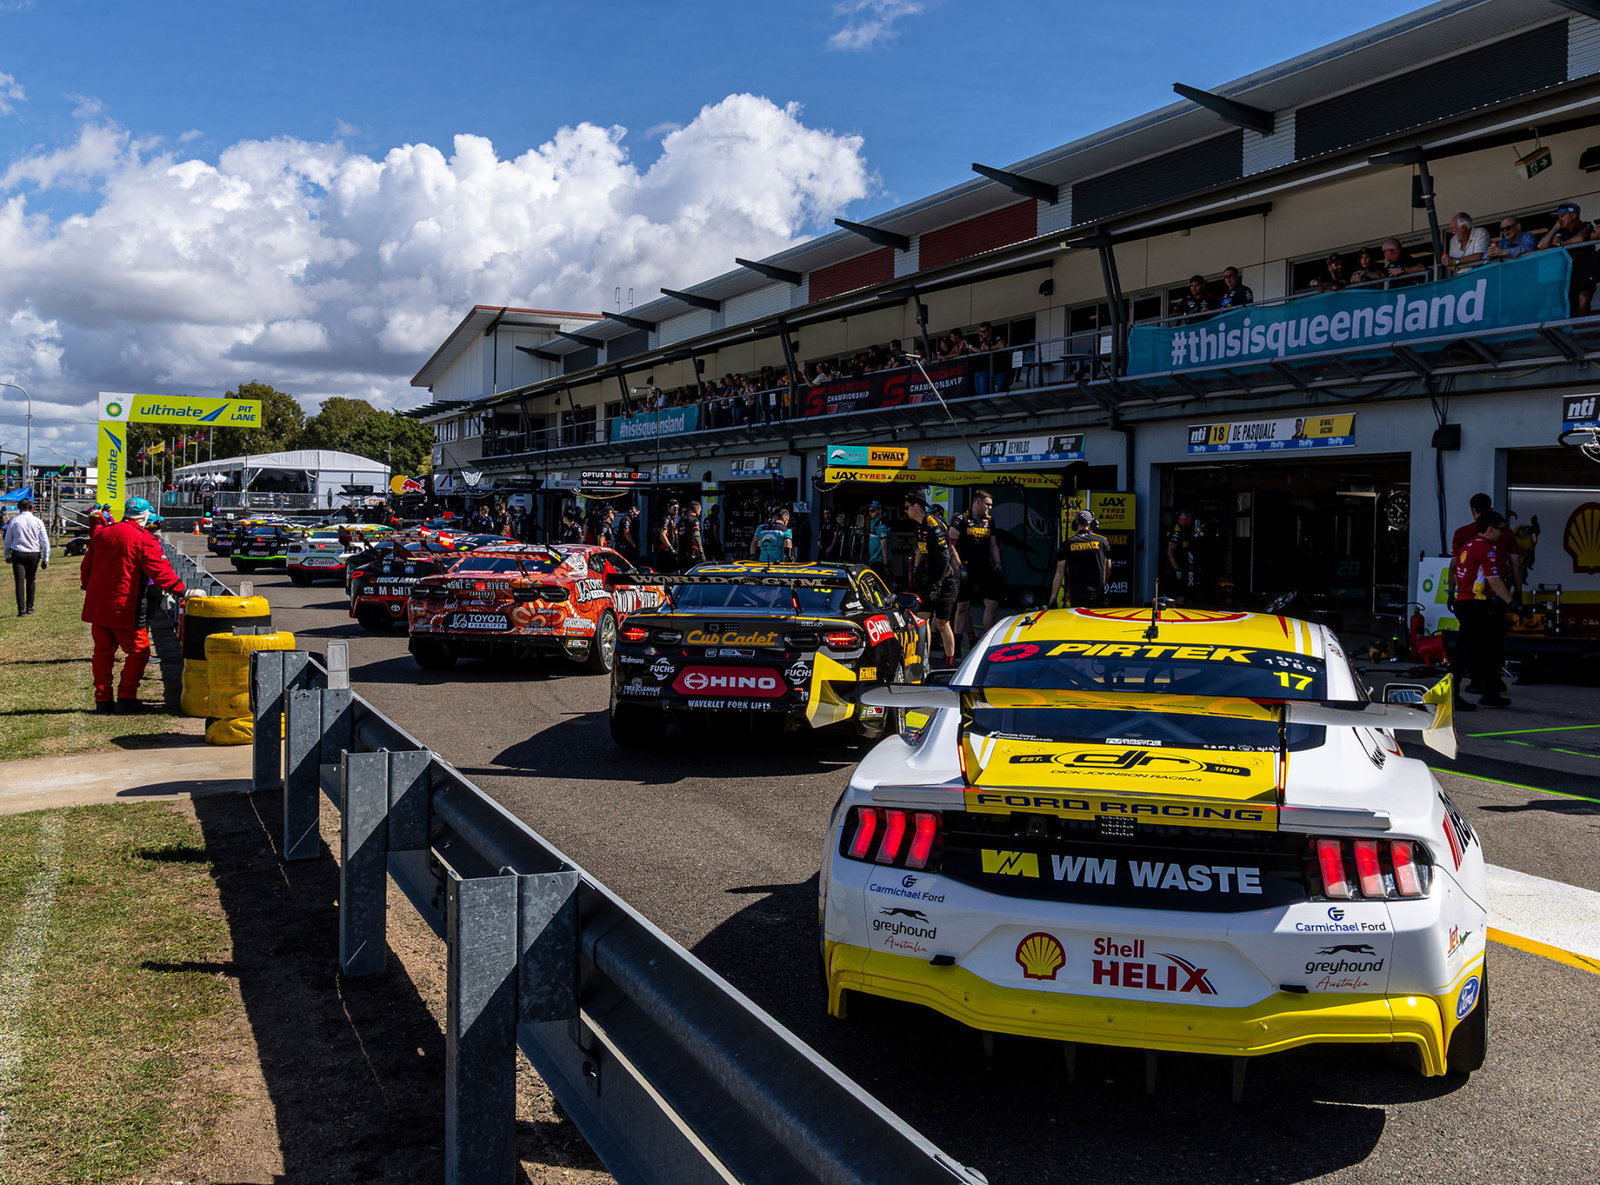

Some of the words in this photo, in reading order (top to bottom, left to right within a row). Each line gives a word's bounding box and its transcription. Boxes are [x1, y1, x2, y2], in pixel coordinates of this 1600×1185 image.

[1171, 278, 1488, 366] #thisisqueensland
[827, 391, 870, 403] CHAMPIONSHIP
[140, 405, 203, 418] ultimate
[238, 405, 253, 413] PIT
[1568, 397, 1595, 417] nti
[230, 413, 256, 421] LANE
[1191, 427, 1206, 442] nti
[1213, 426, 1225, 442] 18
[1233, 425, 1241, 441] DE
[1243, 422, 1277, 441] PASQUALE
[994, 443, 1003, 455] 20
[1008, 440, 1030, 454] REYNOLDS
[109, 449, 118, 499] ultimate
[831, 472, 858, 481] JAX
[992, 475, 1018, 485] JAX
[1098, 498, 1126, 507] JAX
[751, 567, 835, 576] Cadet
[487, 582, 510, 590] RIVER
[630, 575, 728, 585] WORLD
[763, 577, 825, 587] GYM
[379, 586, 403, 596] Mobil
[468, 614, 507, 623] TOYOTA
[687, 630, 720, 646] Cub
[721, 631, 779, 646] Cadet
[1045, 643, 1257, 664] PIRTEK
[1264, 658, 1317, 673] 1980
[1276, 656, 1305, 665] EST.
[650, 665, 675, 673] FUCHS
[784, 669, 812, 677] FUCHS
[710, 677, 776, 690] HINO
[1273, 671, 1313, 691] 17
[688, 699, 725, 710] WAVERLEY
[727, 700, 748, 710] FORK
[751, 701, 771, 711] LIFTS
[1214, 766, 1241, 774] 1980
[1151, 774, 1202, 782] RACING
[977, 794, 1090, 811] FORD
[1101, 800, 1264, 821] RACING
[1051, 853, 1117, 885] WM
[1128, 859, 1263, 895] WASTE
[869, 883, 920, 901] Carmichael
[922, 892, 945, 904] Ford
[872, 918, 937, 940] greyhound
[1295, 921, 1359, 932] Carmichael
[1361, 922, 1387, 931] Ford
[883, 935, 928, 953] Australia
[1093, 937, 1145, 958] Shell
[1305, 959, 1384, 975] greyhound
[1091, 956, 1218, 995] HELIX
[1316, 975, 1370, 989] Australia
